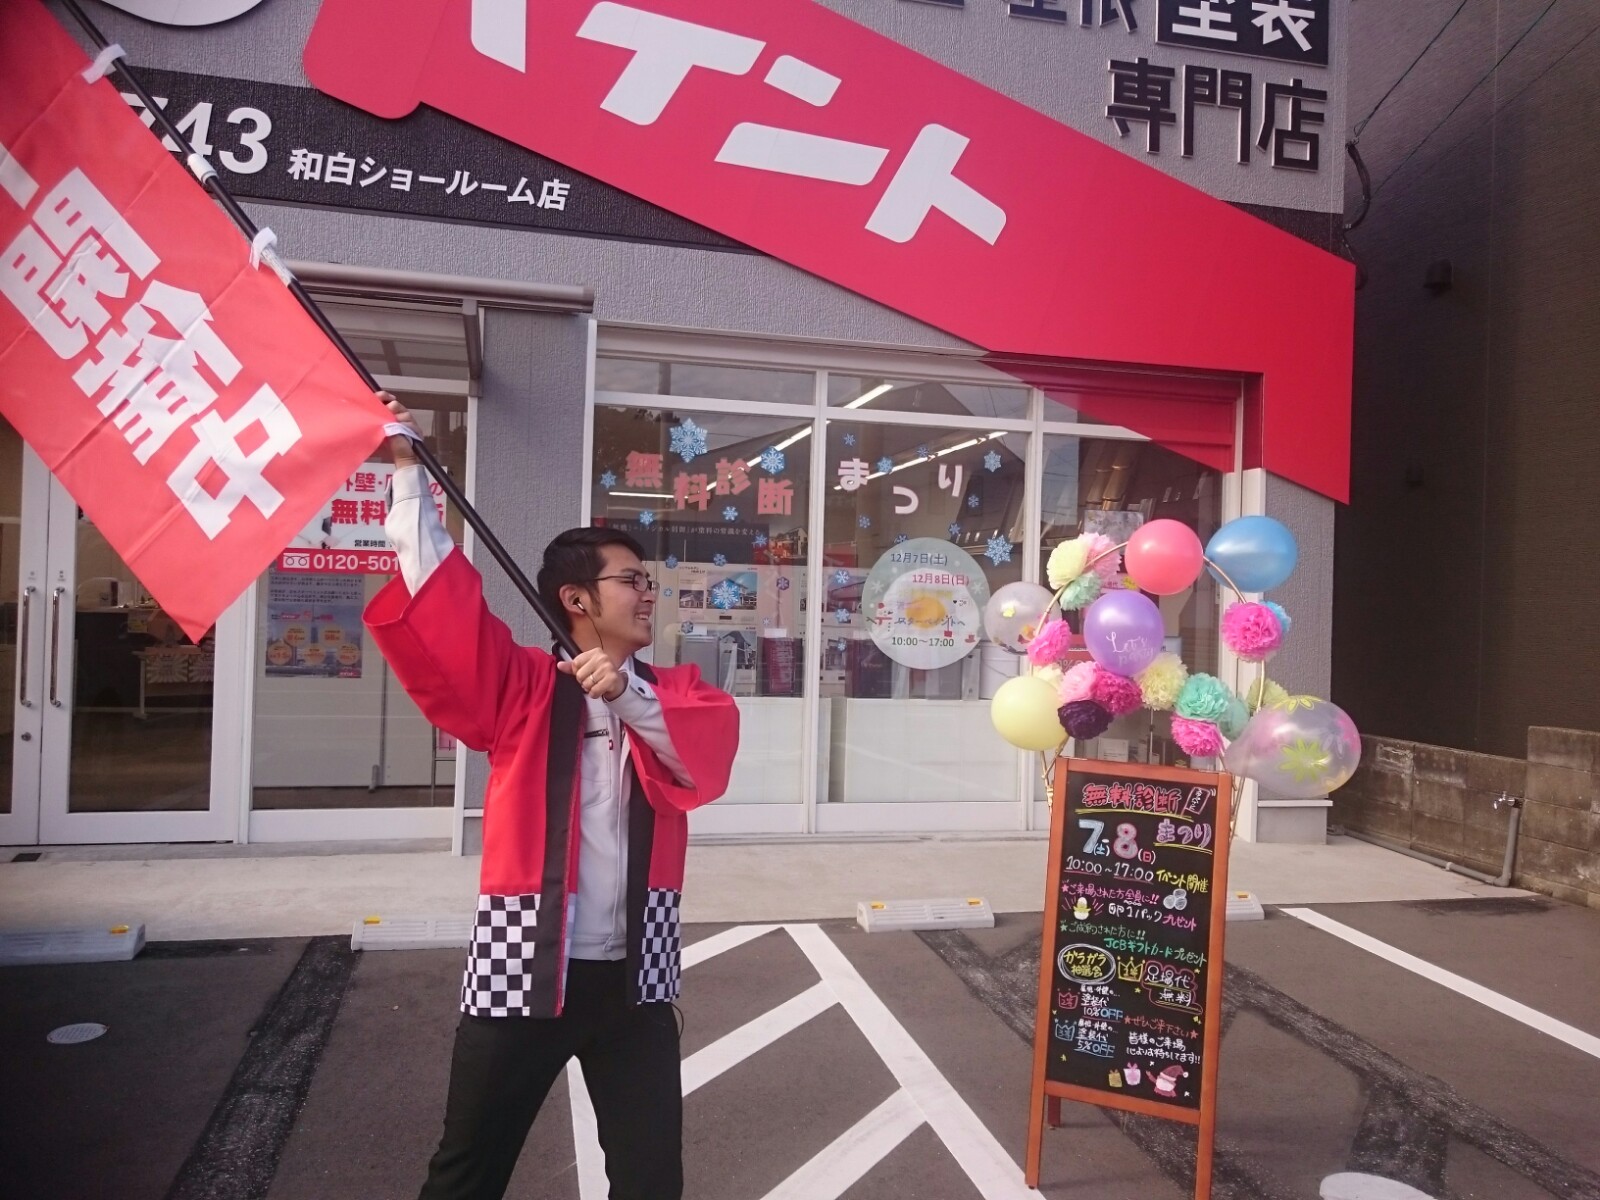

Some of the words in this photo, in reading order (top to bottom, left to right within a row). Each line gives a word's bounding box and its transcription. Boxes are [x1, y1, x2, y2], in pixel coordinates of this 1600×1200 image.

[471, 0, 1006, 246] イント
[1105, 57, 1328, 171] 専門店
[287, 148, 571, 212] 和白ショールーム店
[625, 450, 794, 516] 無料診断
[837, 458, 964, 515] まつり
[354, 539, 386, 548] 営業時間
[891, 553, 948, 566] 12月7日(土)
[912, 573, 969, 586] 12月8日(日)
[1082, 782, 1182, 814] 無料診断
[1156, 818, 1212, 848] まつり
[1063, 950, 1107, 966] ガラガラ
[1144, 965, 1191, 988] 足場代
[1159, 988, 1192, 1007] 無料
